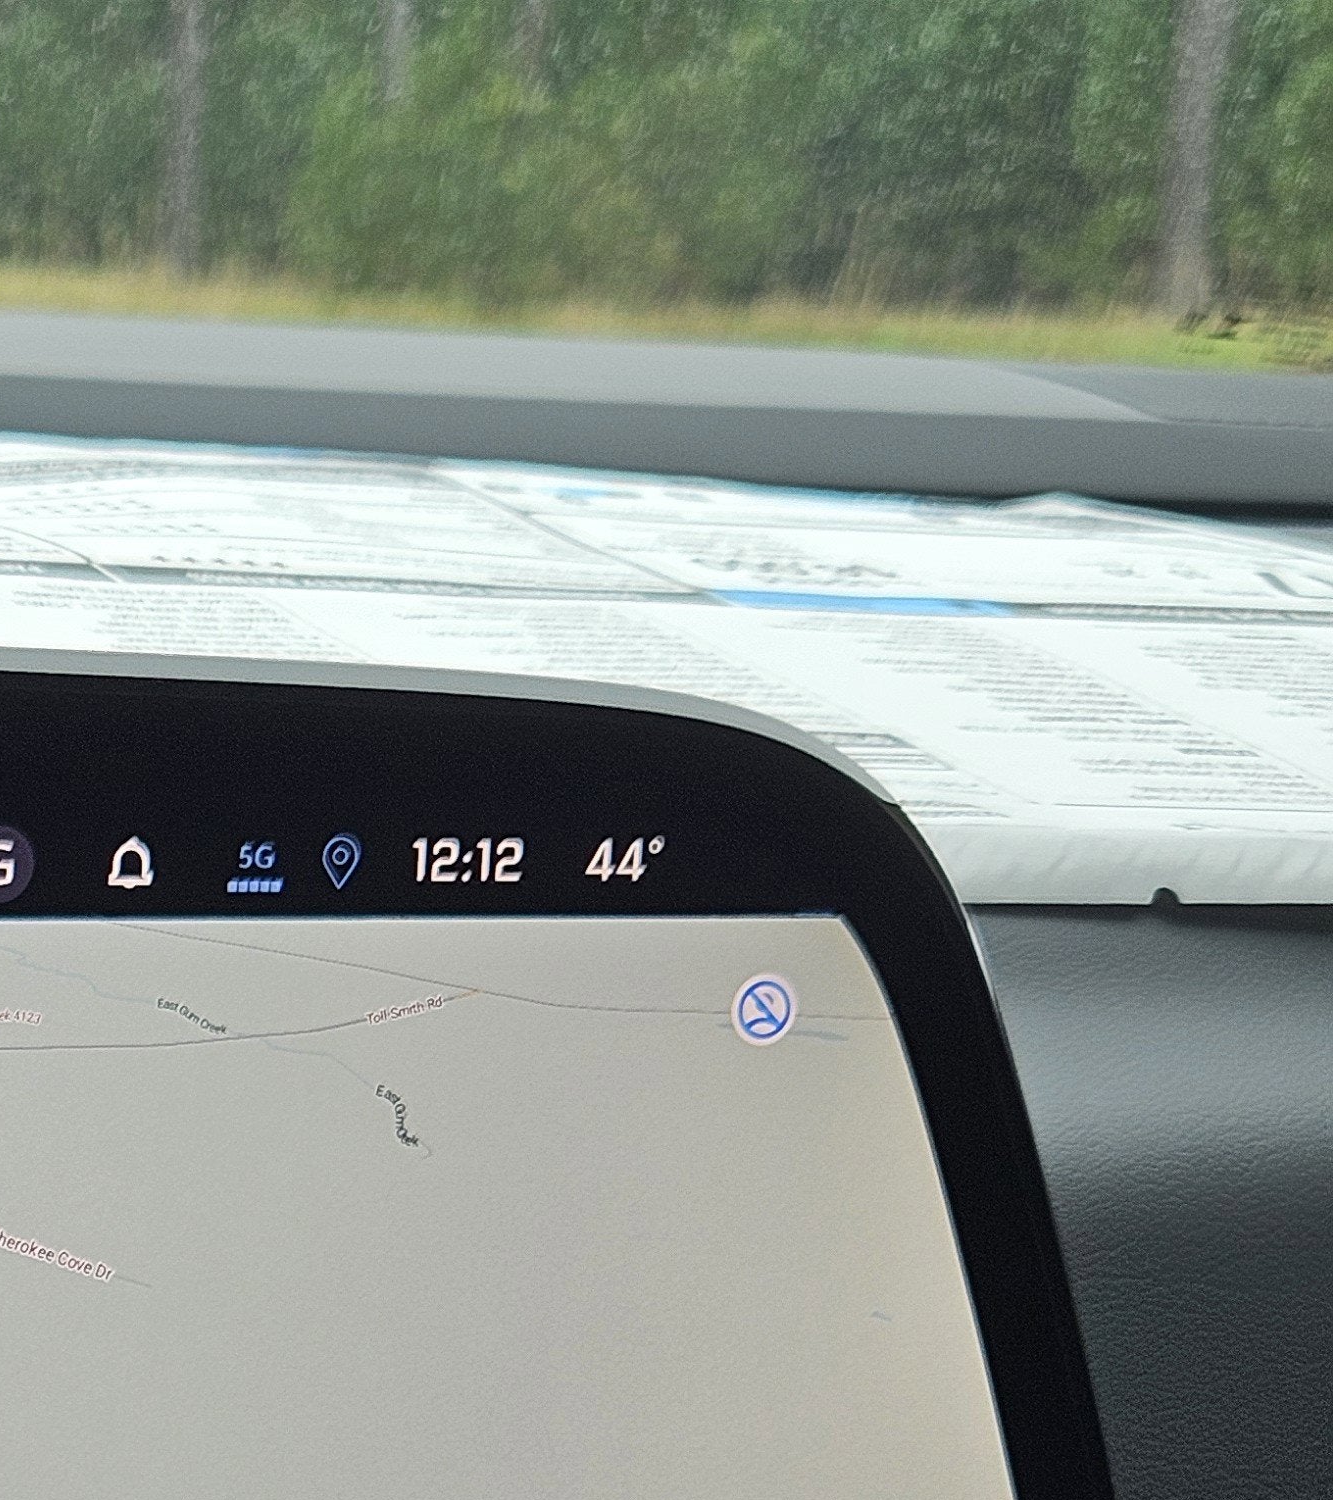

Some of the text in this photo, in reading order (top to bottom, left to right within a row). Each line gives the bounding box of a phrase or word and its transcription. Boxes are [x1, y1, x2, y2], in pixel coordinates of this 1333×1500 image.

[239, 840, 276, 869] 5G
[412, 836, 524, 883] 12:12
[585, 834, 665, 883] 44°
[56, 1250, 94, 1275] Cove
[94, 1262, 114, 1281] Dr
